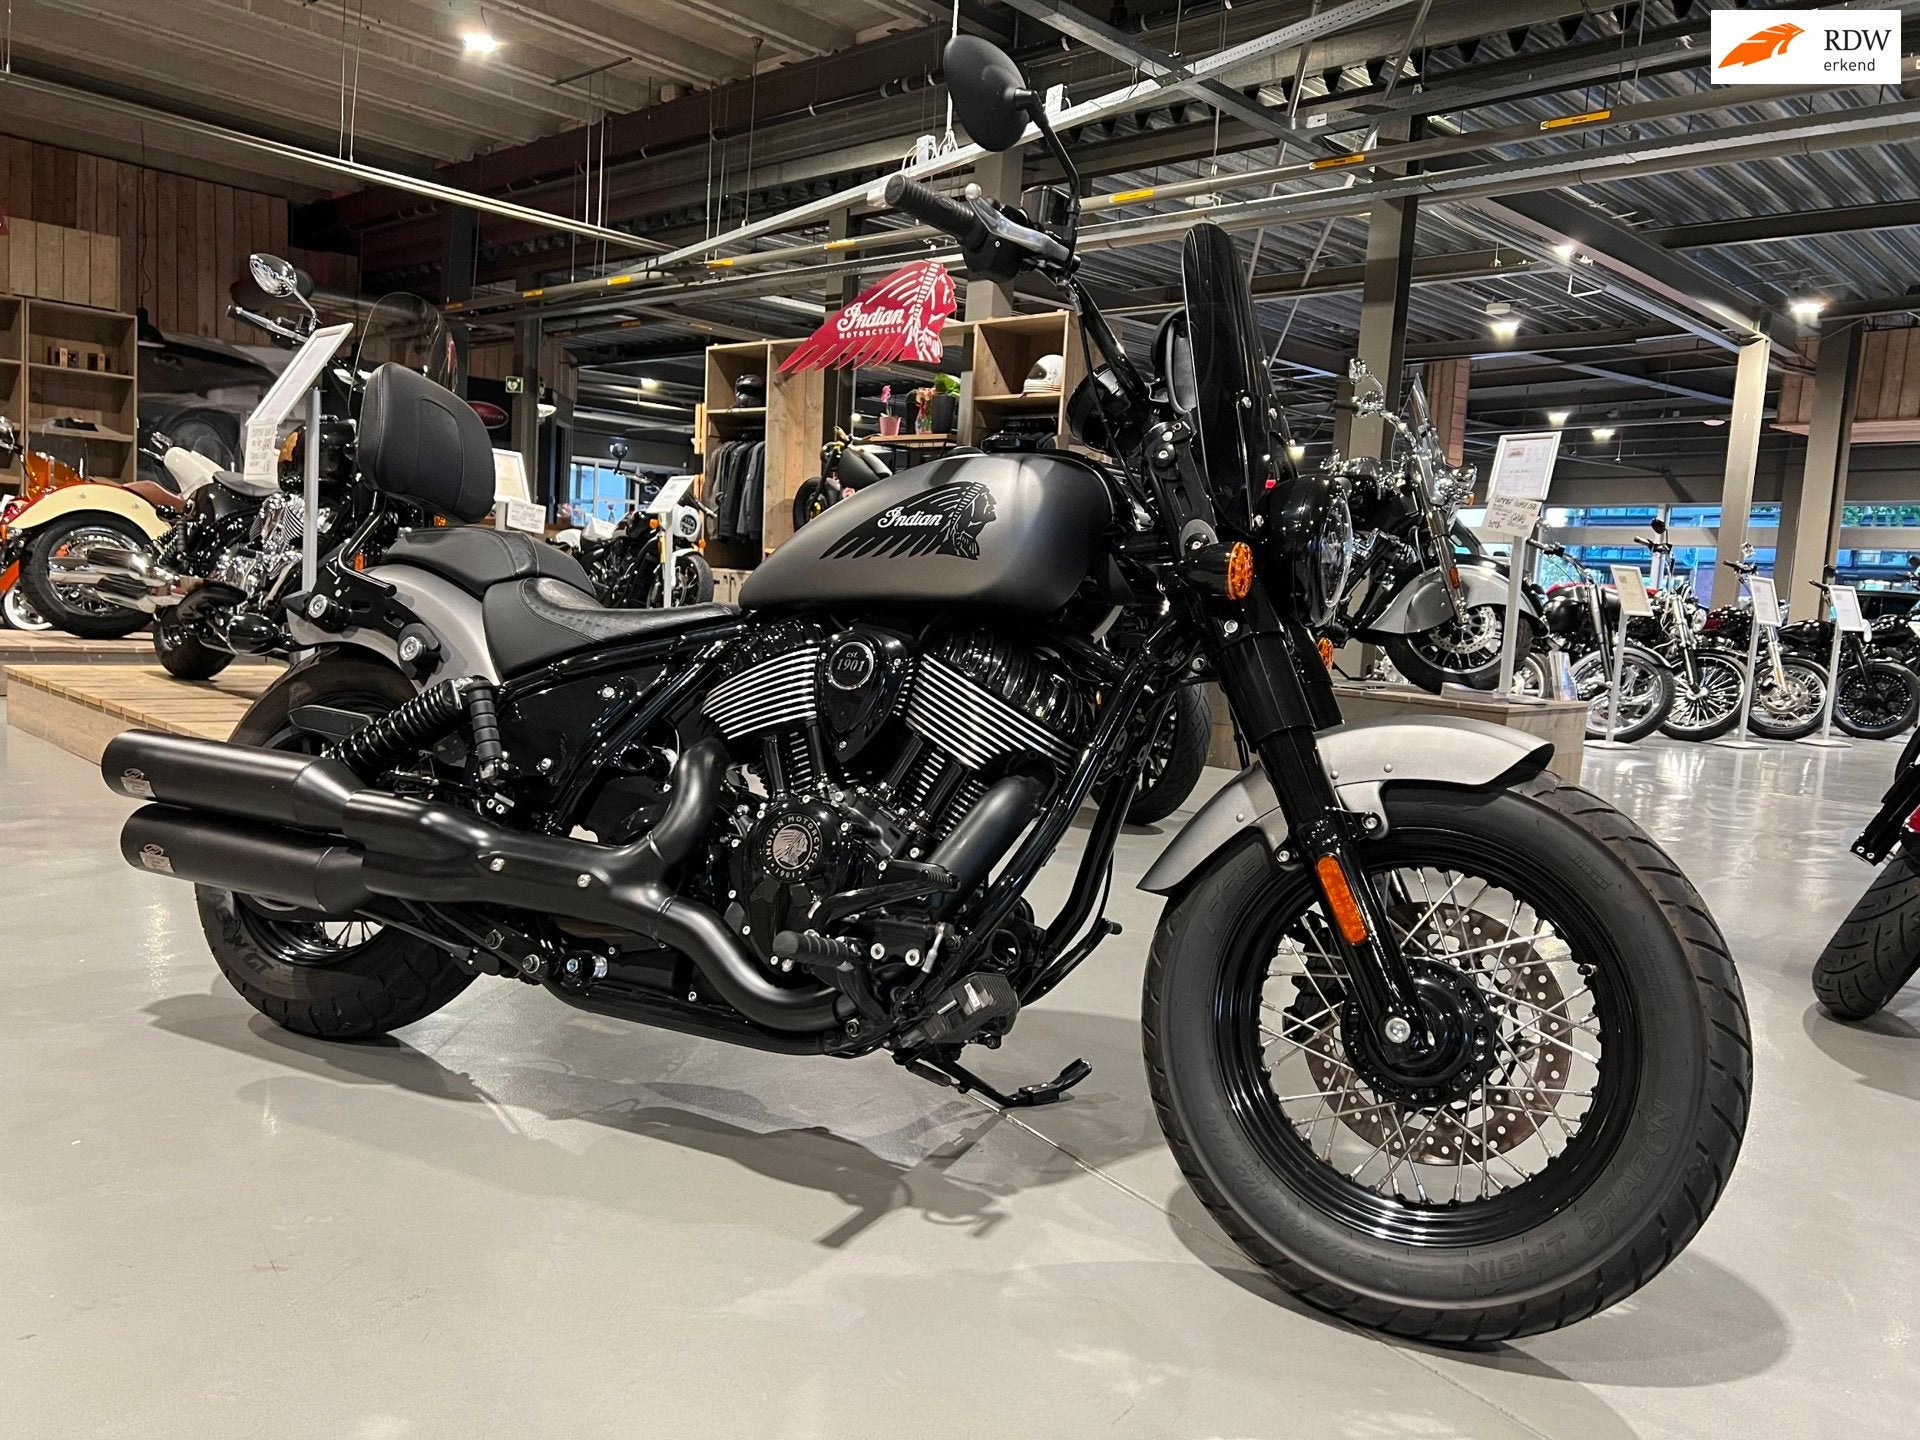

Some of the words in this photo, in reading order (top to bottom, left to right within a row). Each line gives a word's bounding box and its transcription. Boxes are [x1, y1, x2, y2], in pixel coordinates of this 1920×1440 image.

[836, 302, 905, 332] Indian
[839, 326, 902, 339] MOTORCYCLE
[877, 506, 943, 528] Indian
[837, 658, 866, 672] 1901
[765, 820, 785, 860] INDIAN
[787, 815, 820, 872] MOTORCYCLE
[1579, 1100, 1677, 1241] DRAGON
[1460, 1231, 1567, 1285] NIGHT
